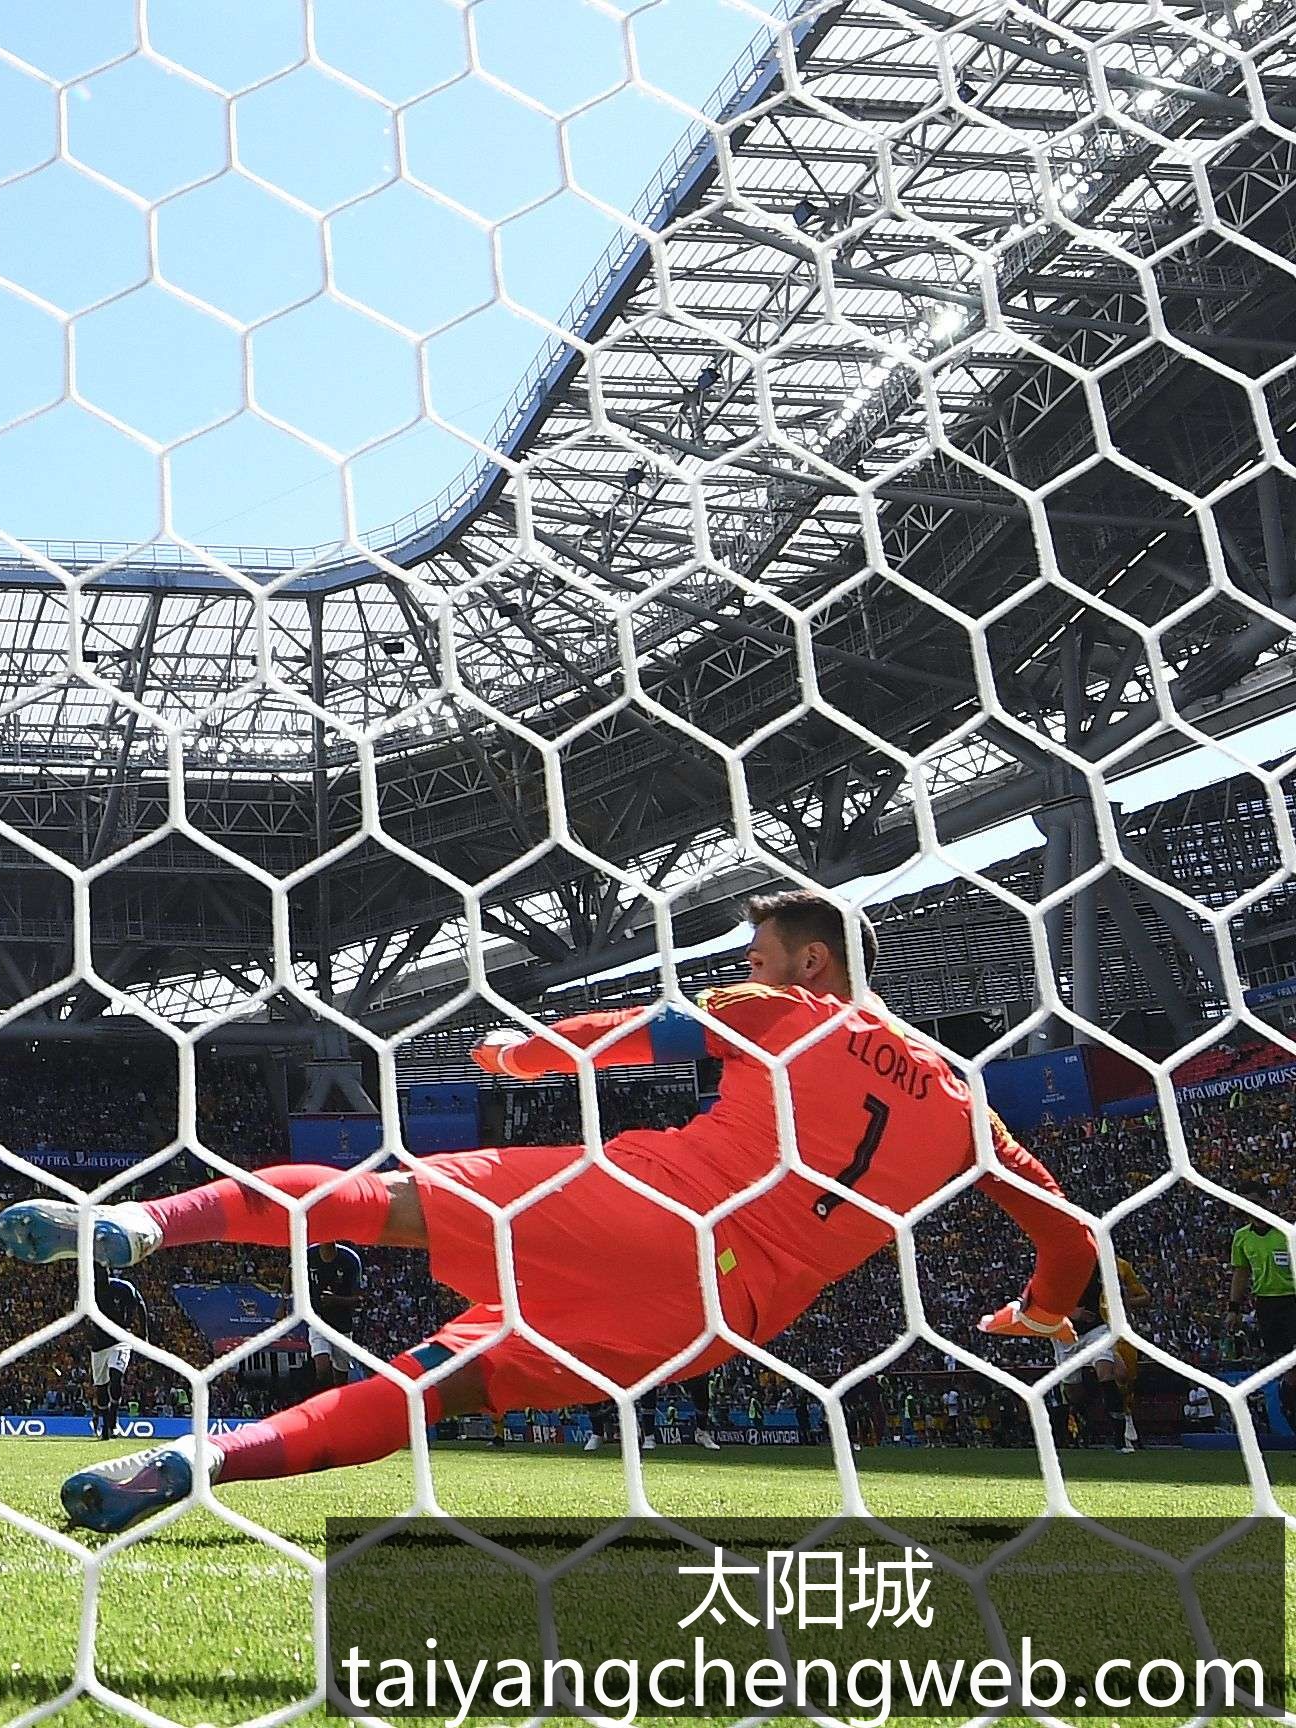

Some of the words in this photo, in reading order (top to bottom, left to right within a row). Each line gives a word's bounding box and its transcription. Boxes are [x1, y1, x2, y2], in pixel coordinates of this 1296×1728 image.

[847, 1031, 933, 1100] LLORIS
[1183, 1086, 1206, 1103] FIFA
[1244, 1073, 1267, 1090] CUP
[46, 1155, 71, 1166] FIFA
[109, 1157, 144, 1168] РОСС
[812, 1092, 891, 1222] 7
[659, 1427, 682, 1444] VISA
[761, 1430, 801, 1444] HYUNDAI
